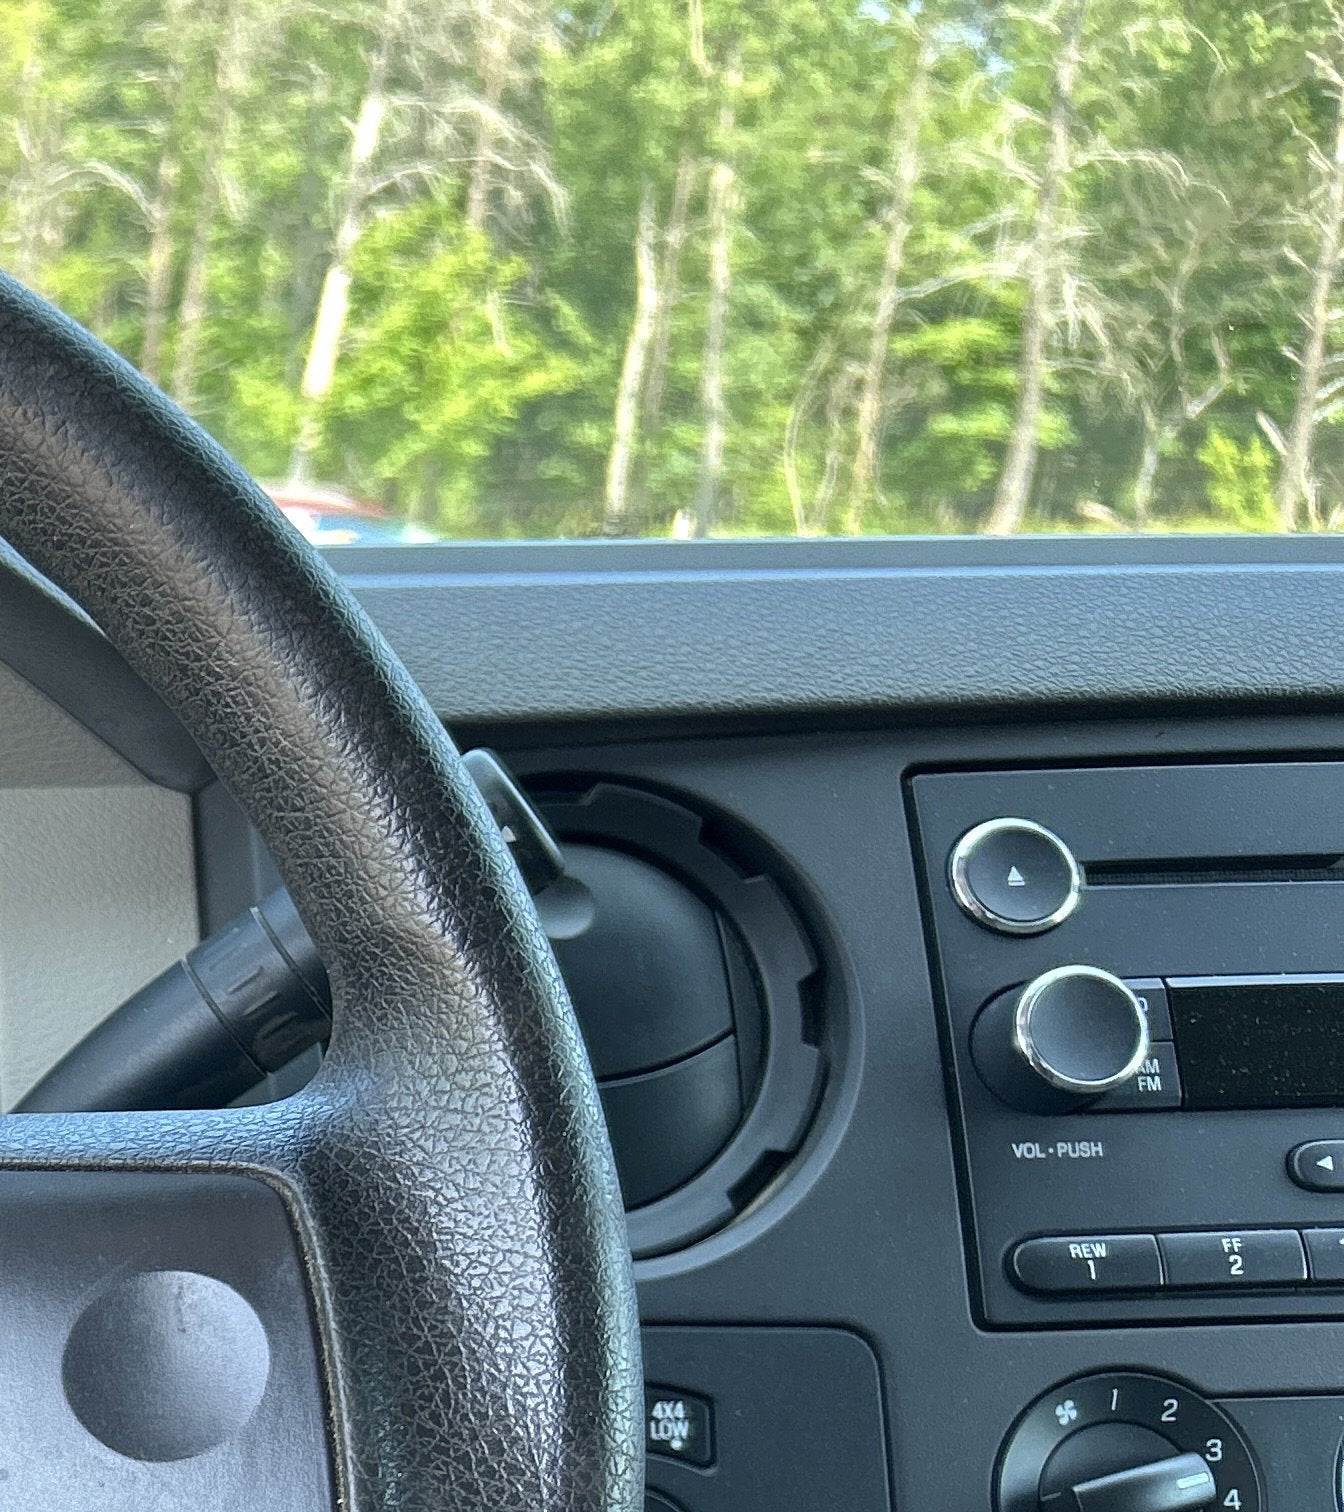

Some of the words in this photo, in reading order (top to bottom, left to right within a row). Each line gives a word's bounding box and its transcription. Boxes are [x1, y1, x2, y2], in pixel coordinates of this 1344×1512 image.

[1137, 1075, 1162, 1092] FM
[1069, 1242, 1107, 1259] REW
[1221, 1237, 1243, 1253] FF
[1086, 1260, 1097, 1280] 1
[1228, 1254, 1244, 1276] 2
[651, 1400, 685, 1420] 4X4
[1111, 1388, 1119, 1411] 1
[1161, 1399, 1179, 1422] 2
[649, 1418, 690, 1441] LOW
[1205, 1438, 1223, 1462] 3
[1223, 1488, 1242, 1511] 4
